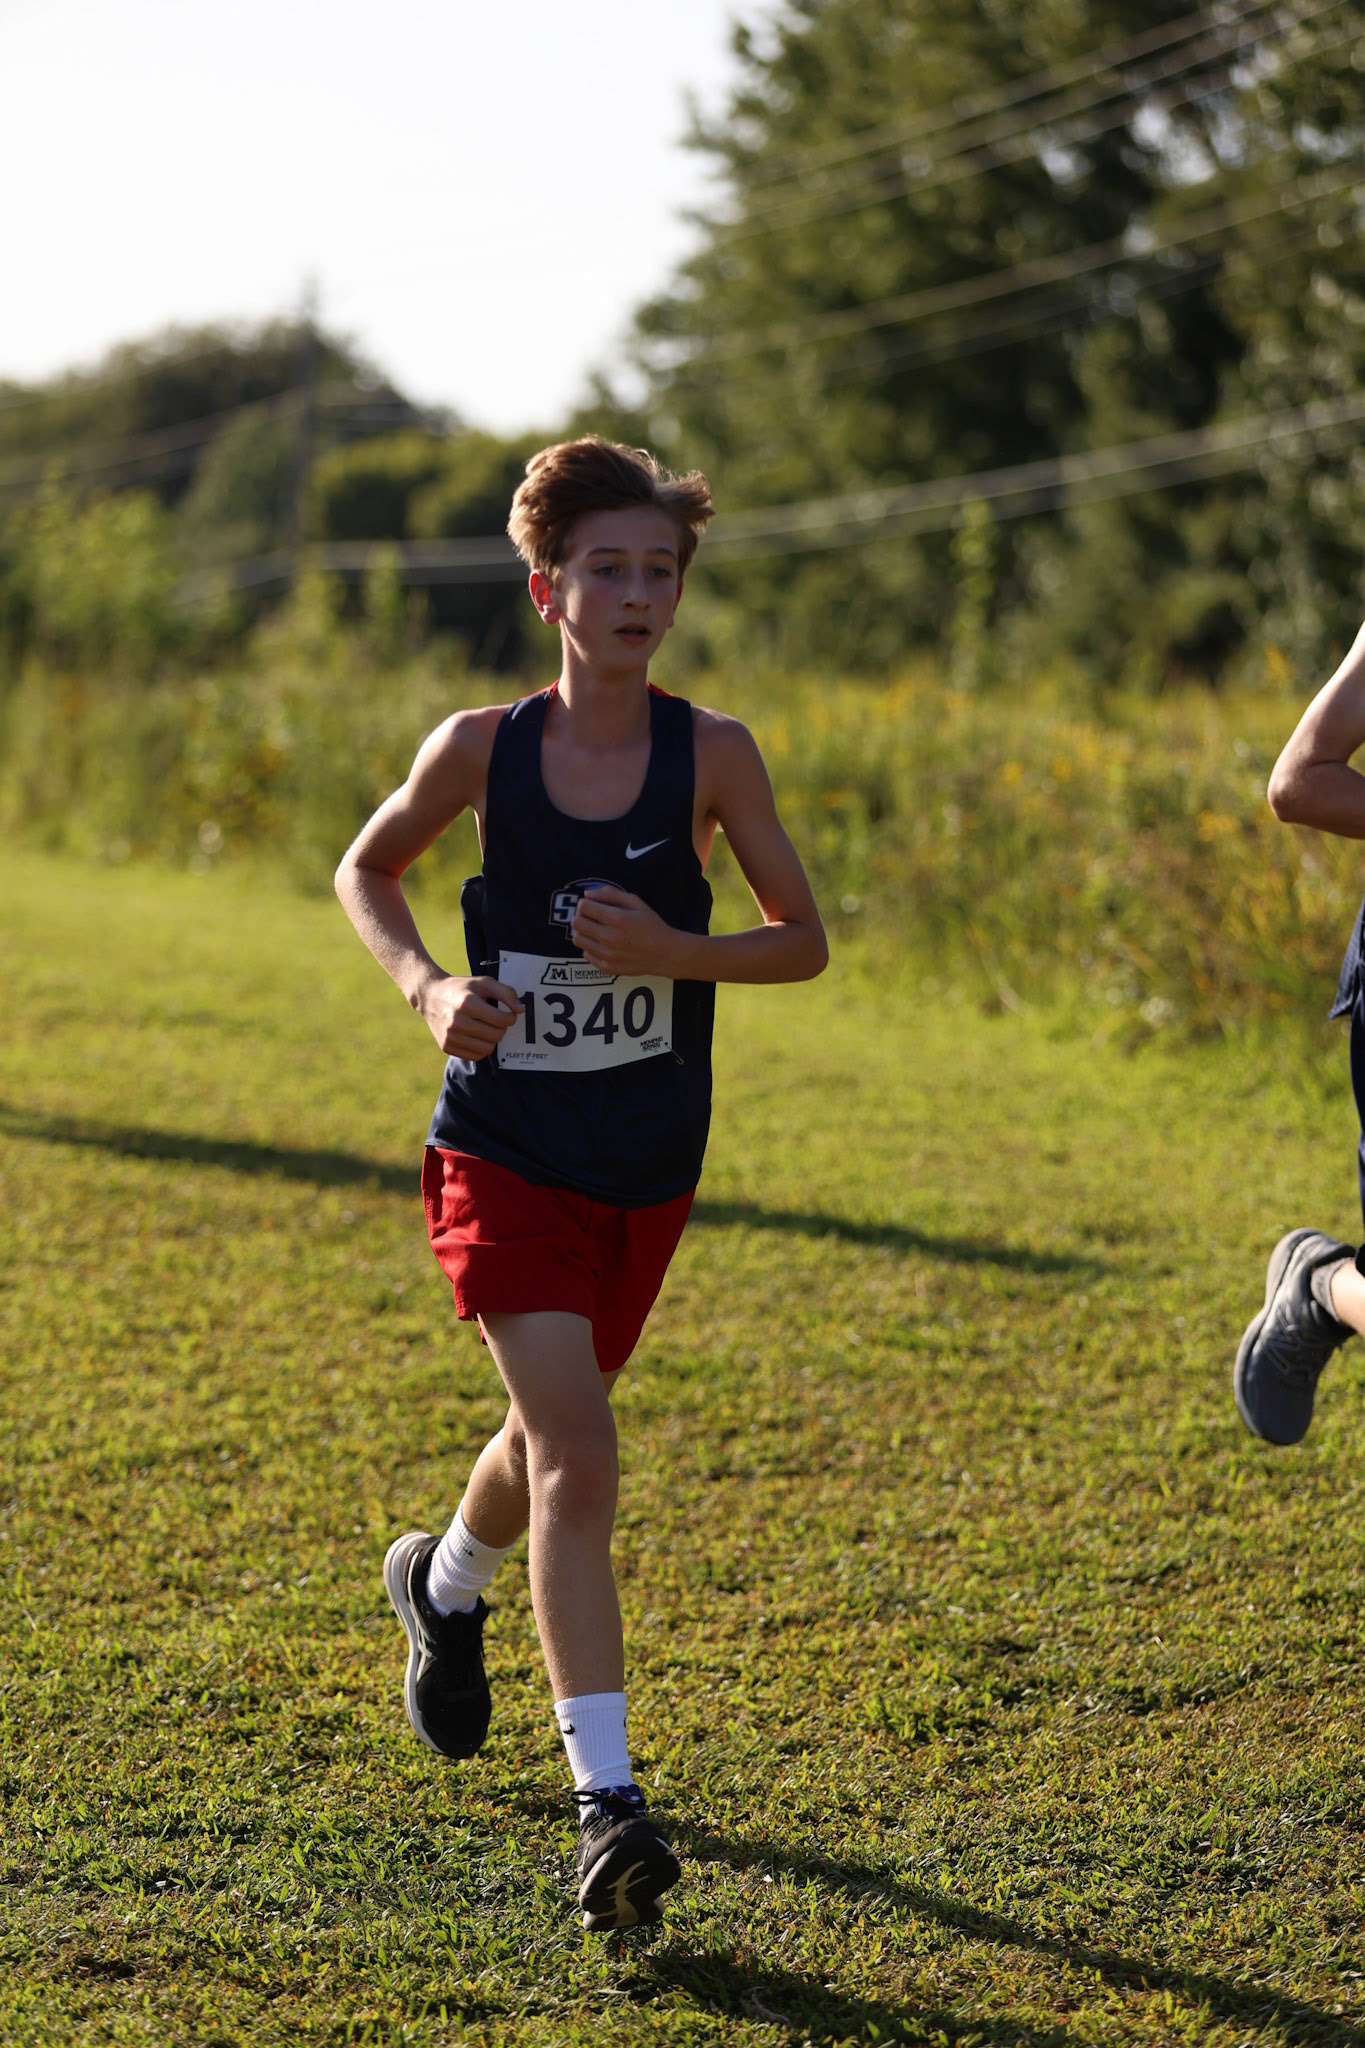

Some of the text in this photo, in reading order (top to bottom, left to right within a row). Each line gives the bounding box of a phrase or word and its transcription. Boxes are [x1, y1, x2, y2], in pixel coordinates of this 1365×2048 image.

[553, 893, 579, 923] S
[549, 968, 569, 981] M
[574, 969, 609, 977] MEMPH
[518, 986, 655, 1047] 1340
